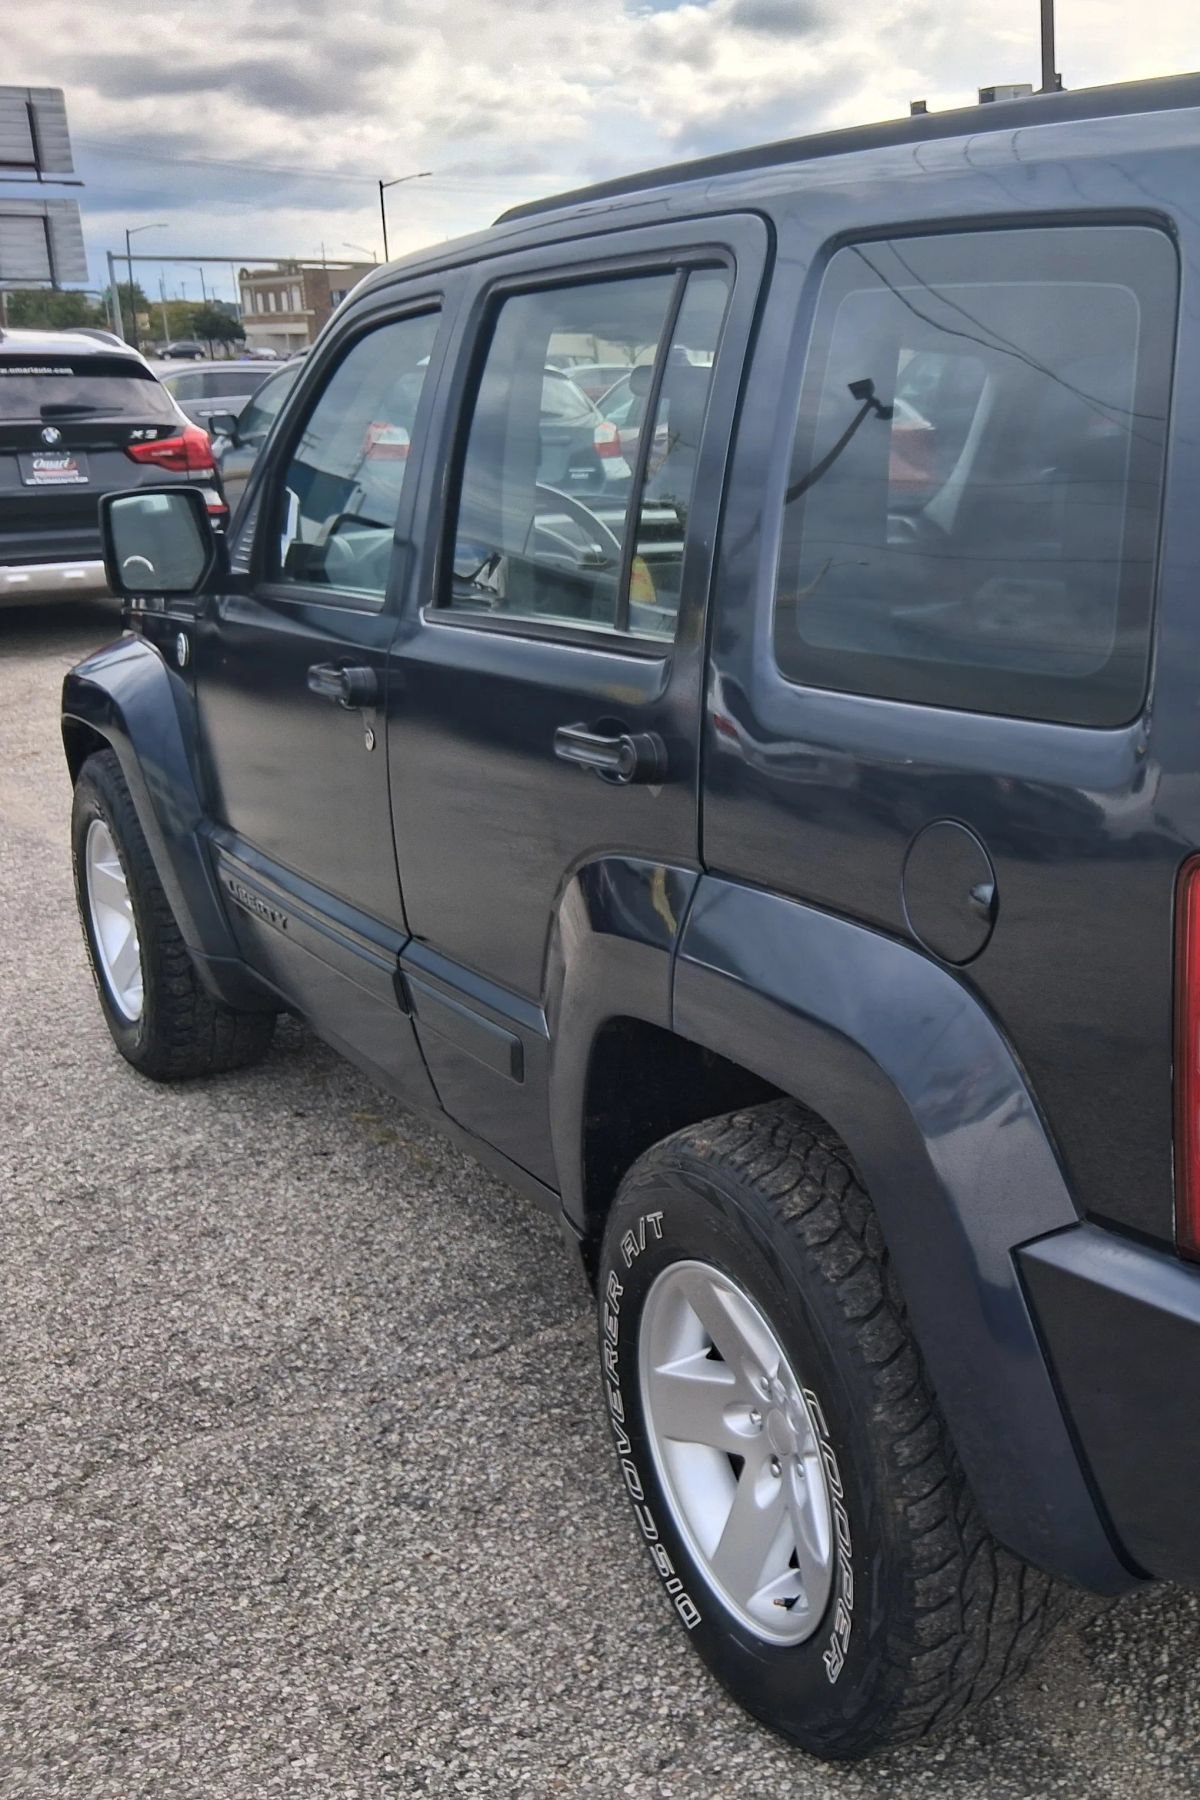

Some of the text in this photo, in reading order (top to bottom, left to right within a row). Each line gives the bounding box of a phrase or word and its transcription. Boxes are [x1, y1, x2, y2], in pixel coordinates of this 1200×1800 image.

[603, 1211, 702, 1630] DISCOVERER A/T
[802, 1388, 854, 1684] COOPER
